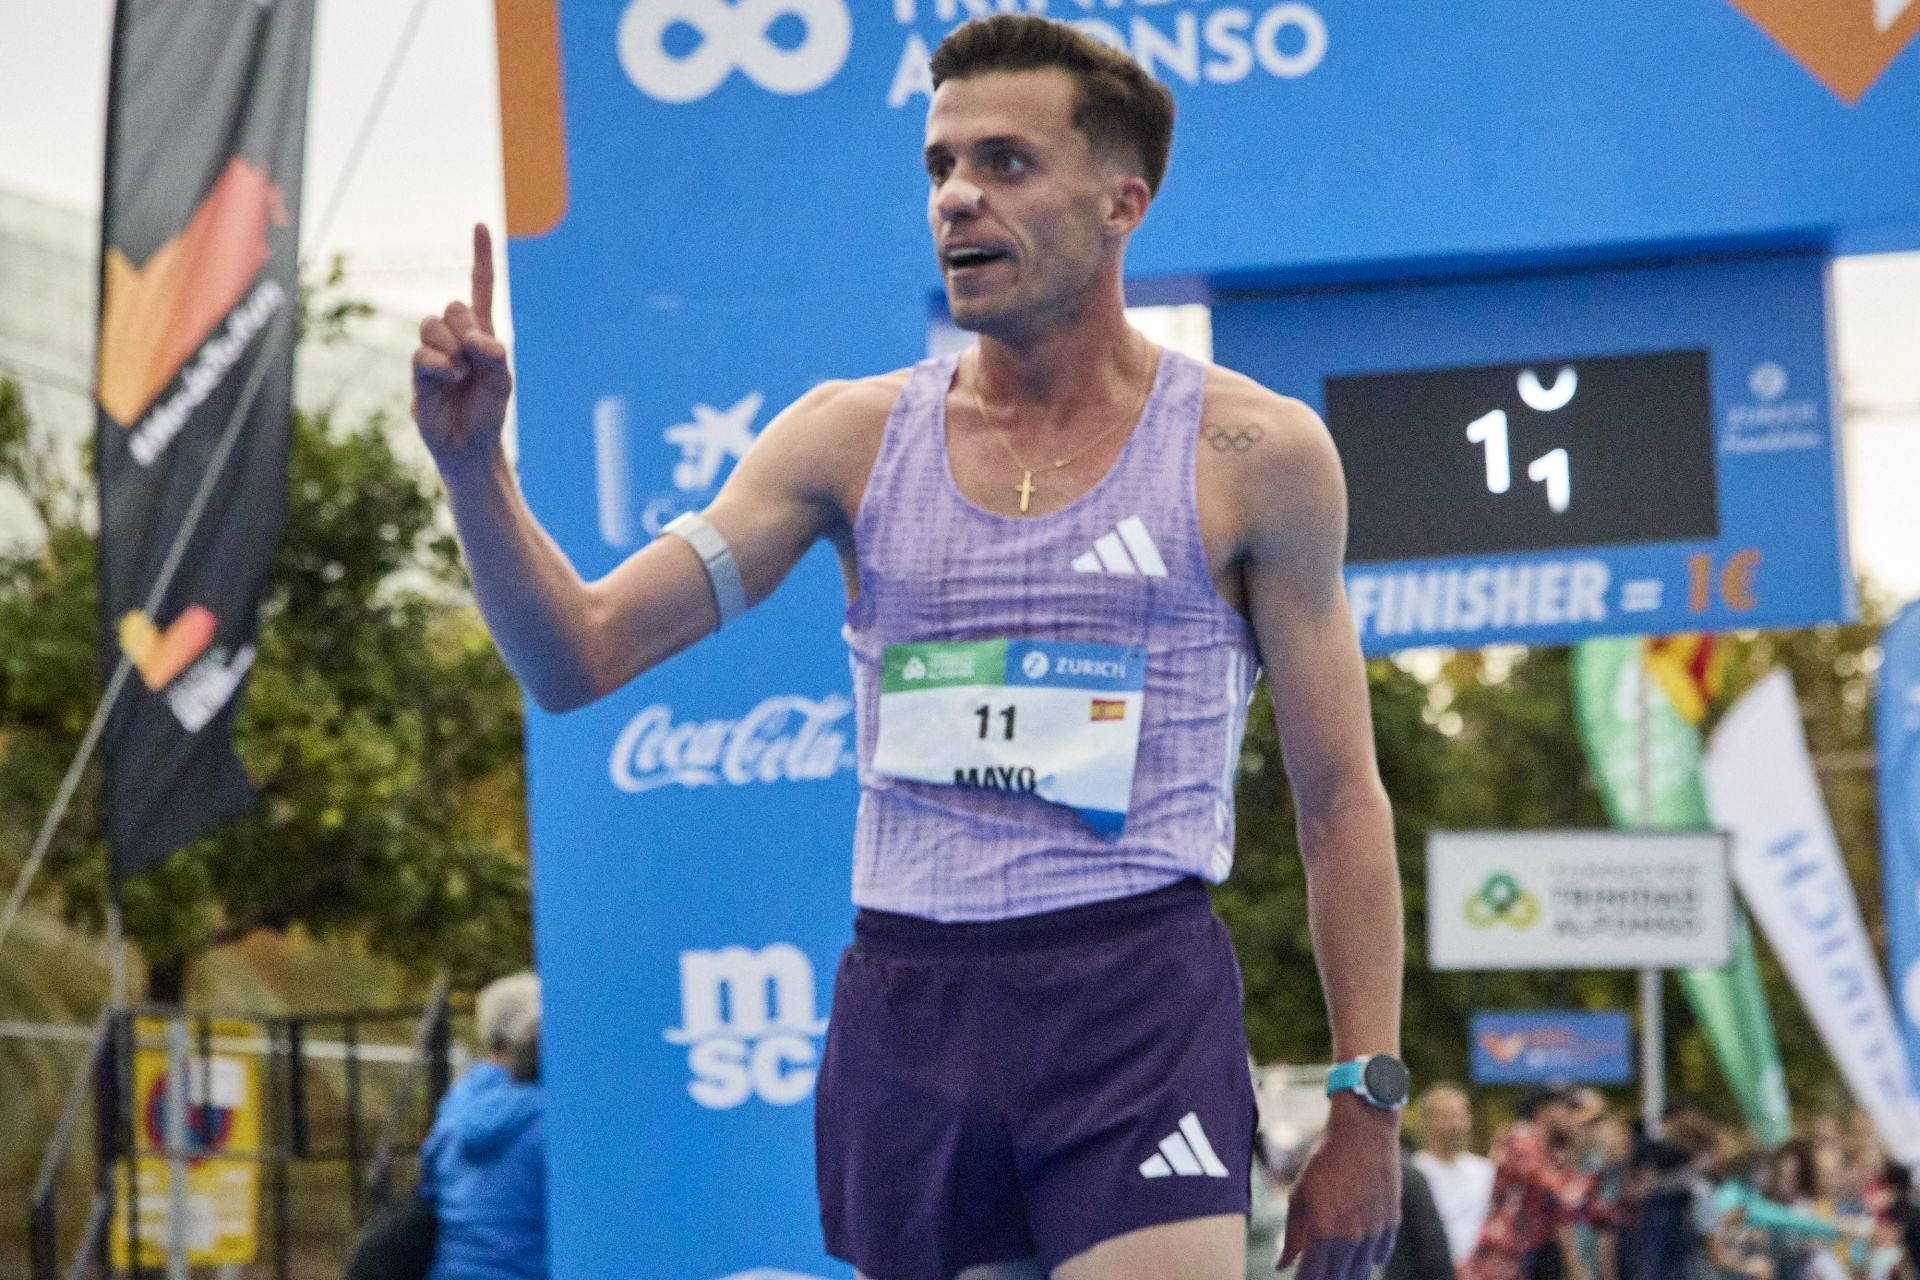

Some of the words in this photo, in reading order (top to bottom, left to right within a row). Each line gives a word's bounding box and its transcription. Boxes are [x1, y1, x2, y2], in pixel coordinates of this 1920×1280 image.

[887, 4, 1328, 106] ANSO
[1350, 559, 1611, 637] FINISHER
[1055, 656, 1127, 679] ZURICH
[974, 704, 1016, 741] 11
[954, 766, 1036, 793] MAYO
